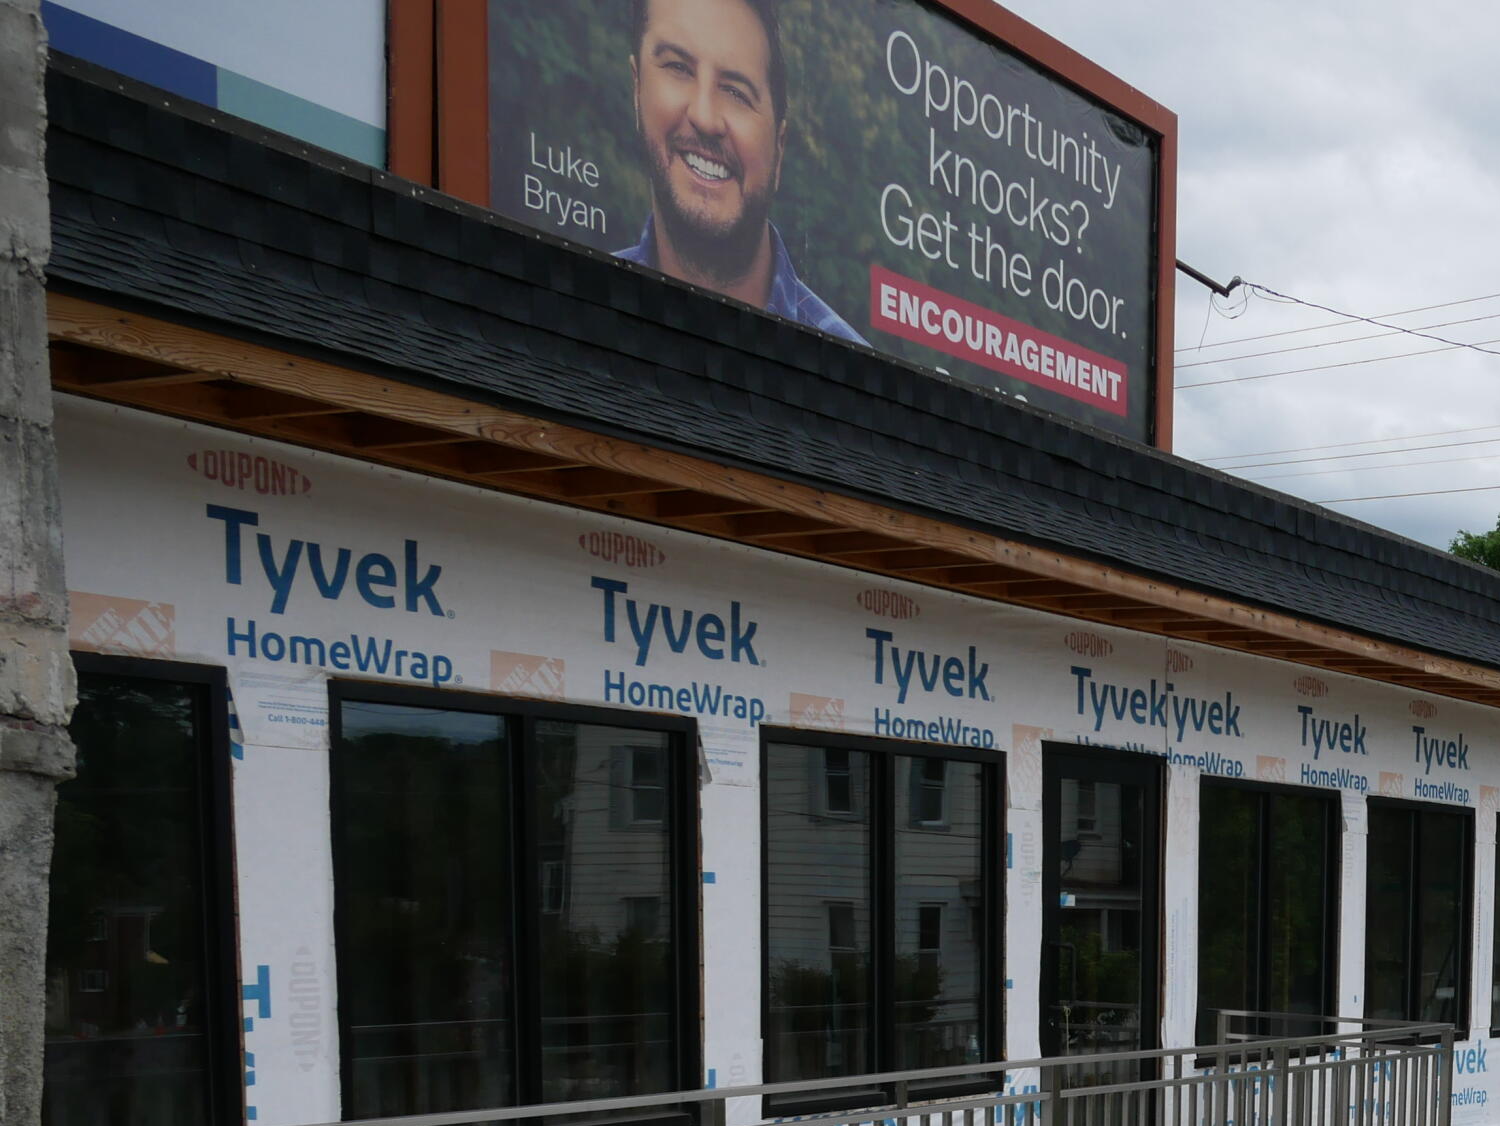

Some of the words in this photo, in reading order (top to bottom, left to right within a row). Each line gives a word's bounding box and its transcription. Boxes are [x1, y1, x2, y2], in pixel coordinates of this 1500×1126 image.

[886, 30, 1121, 210] Opportunity
[529, 132, 600, 188] Luke
[523, 174, 607, 234] Bryan
[929, 127, 1090, 254] knocks?
[880, 183, 959, 270] Get
[969, 222, 1032, 297] the
[1042, 260, 1127, 340] door.
[880, 283, 1122, 402] ENCOURAGEMENT
[204, 449, 299, 495] DUPONT
[589, 531, 657, 568] DUPONT
[864, 589, 914, 620] DUPONT
[1297, 704, 1367, 761] Tyvek
[1412, 725, 1469, 776] Tyvek
